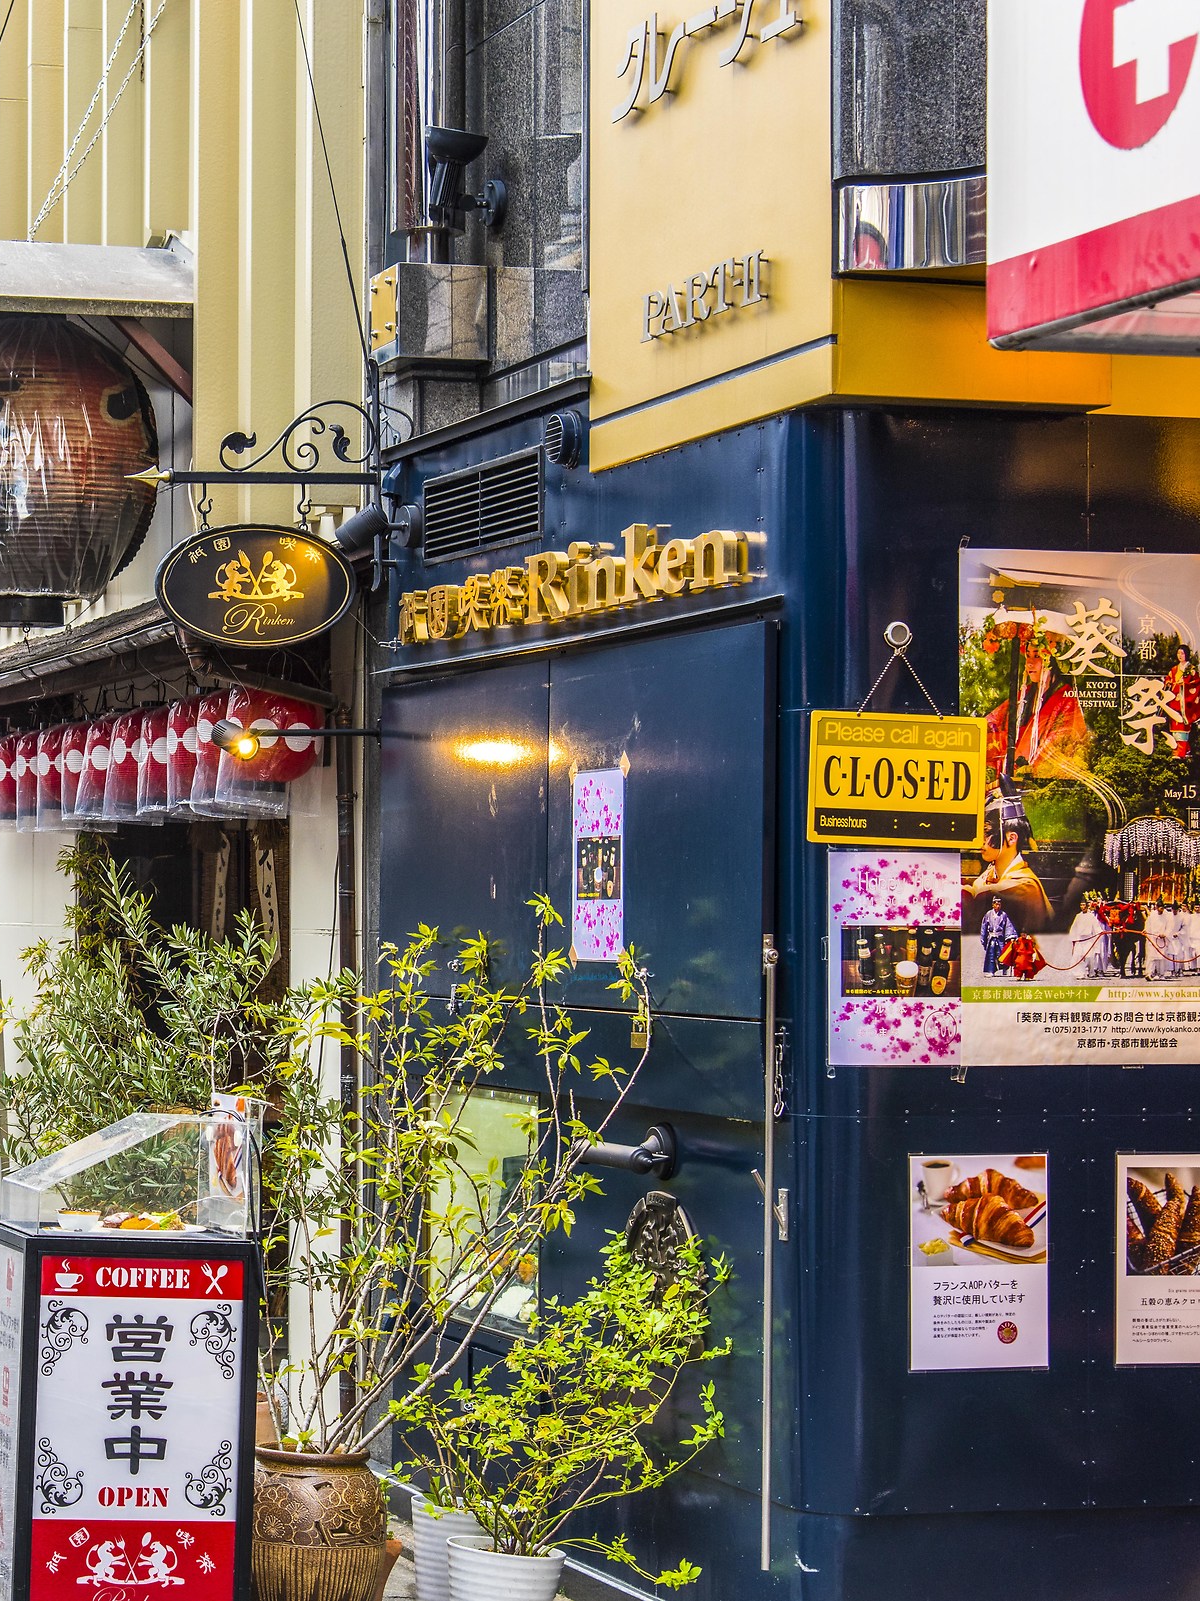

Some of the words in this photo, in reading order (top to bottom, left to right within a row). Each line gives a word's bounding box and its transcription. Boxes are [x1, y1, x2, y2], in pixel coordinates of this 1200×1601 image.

[524, 523, 743, 625] Rinken
[221, 602, 296, 636] Rinken
[1138, 614, 1157, 660] 京都
[1085, 681, 1117, 689] KYOTO
[1063, 690, 1078, 698] AOI
[1079, 690, 1117, 699] MATSURI
[1079, 700, 1117, 708] FESTIVAL
[824, 721, 885, 743] Please
[890, 725, 919, 745] call
[923, 727, 972, 748] again
[1164, 788, 1182, 801] May
[1182, 784, 1197, 799] 15
[972, 989, 1090, 1000] 京都市観光協会Webサイト
[1077, 1038, 1178, 1049] 京都市・京都市観光協会
[95, 1266, 190, 1289] COFFEE
[933, 1280, 1019, 1291] フランスAOPバターを
[933, 1293, 1026, 1306] 贅沢に使用しています
[101, 1313, 174, 1475] 営業中
[97, 1486, 170, 1508] OPEN
